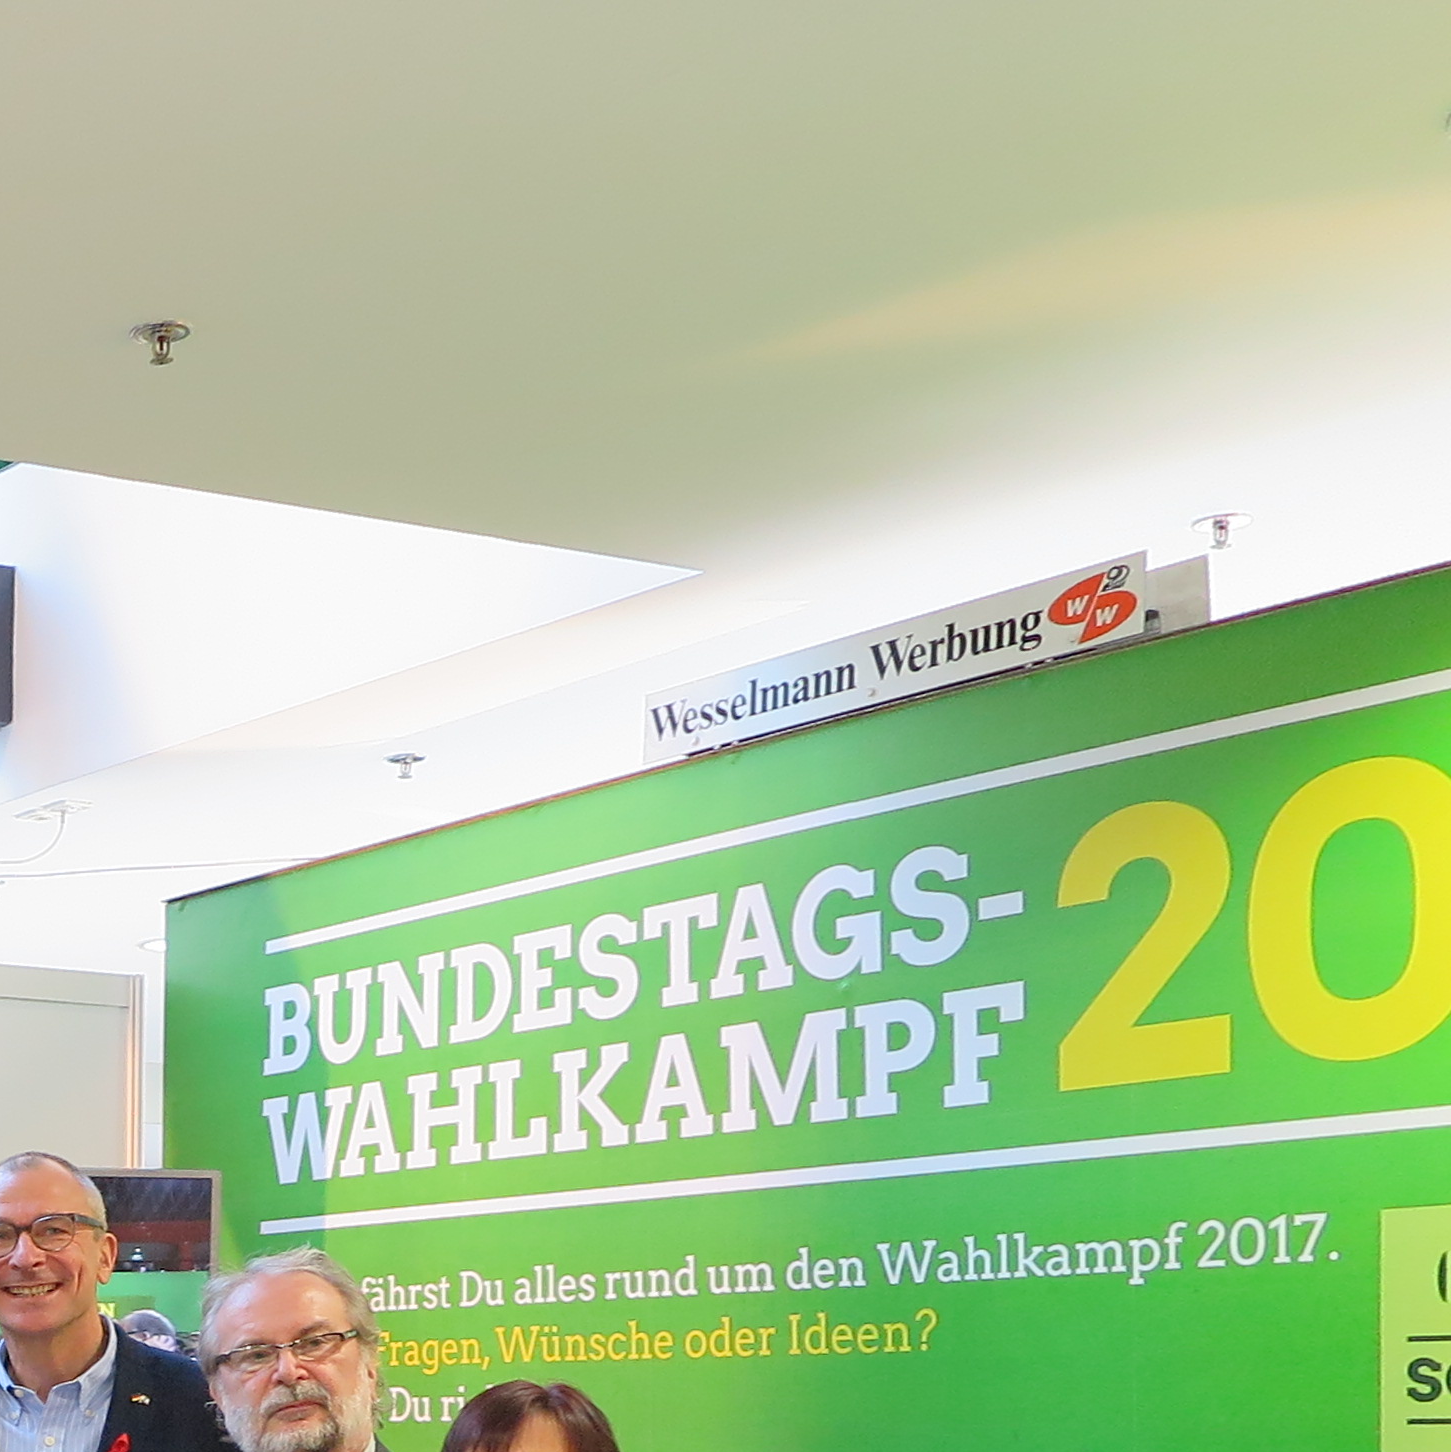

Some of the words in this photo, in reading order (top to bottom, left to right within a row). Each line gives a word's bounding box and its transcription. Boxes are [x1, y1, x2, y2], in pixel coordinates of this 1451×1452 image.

[649, 660, 857, 743] Wesselmann
[869, 608, 1043, 682] Werbung
[262, 844, 1025, 1078] BUNDESTAGS-
[261, 980, 1026, 1186] WAHLKAMPF
[359, 1274, 452, 1313] fährst
[458, 1269, 505, 1308] Du
[513, 1264, 597, 1306] alles
[604, 1255, 698, 1301] rund
[707, 1260, 776, 1295] um
[785, 1247, 867, 1291] den
[876, 1220, 1189, 1286] Wahlkampf
[1196, 1212, 1340, 1269] 2017.
[494, 1319, 674, 1364] Wünsche
[683, 1316, 777, 1359] oder
[787, 1307, 939, 1357] Ideen?
[388, 1386, 432, 1422] Du
